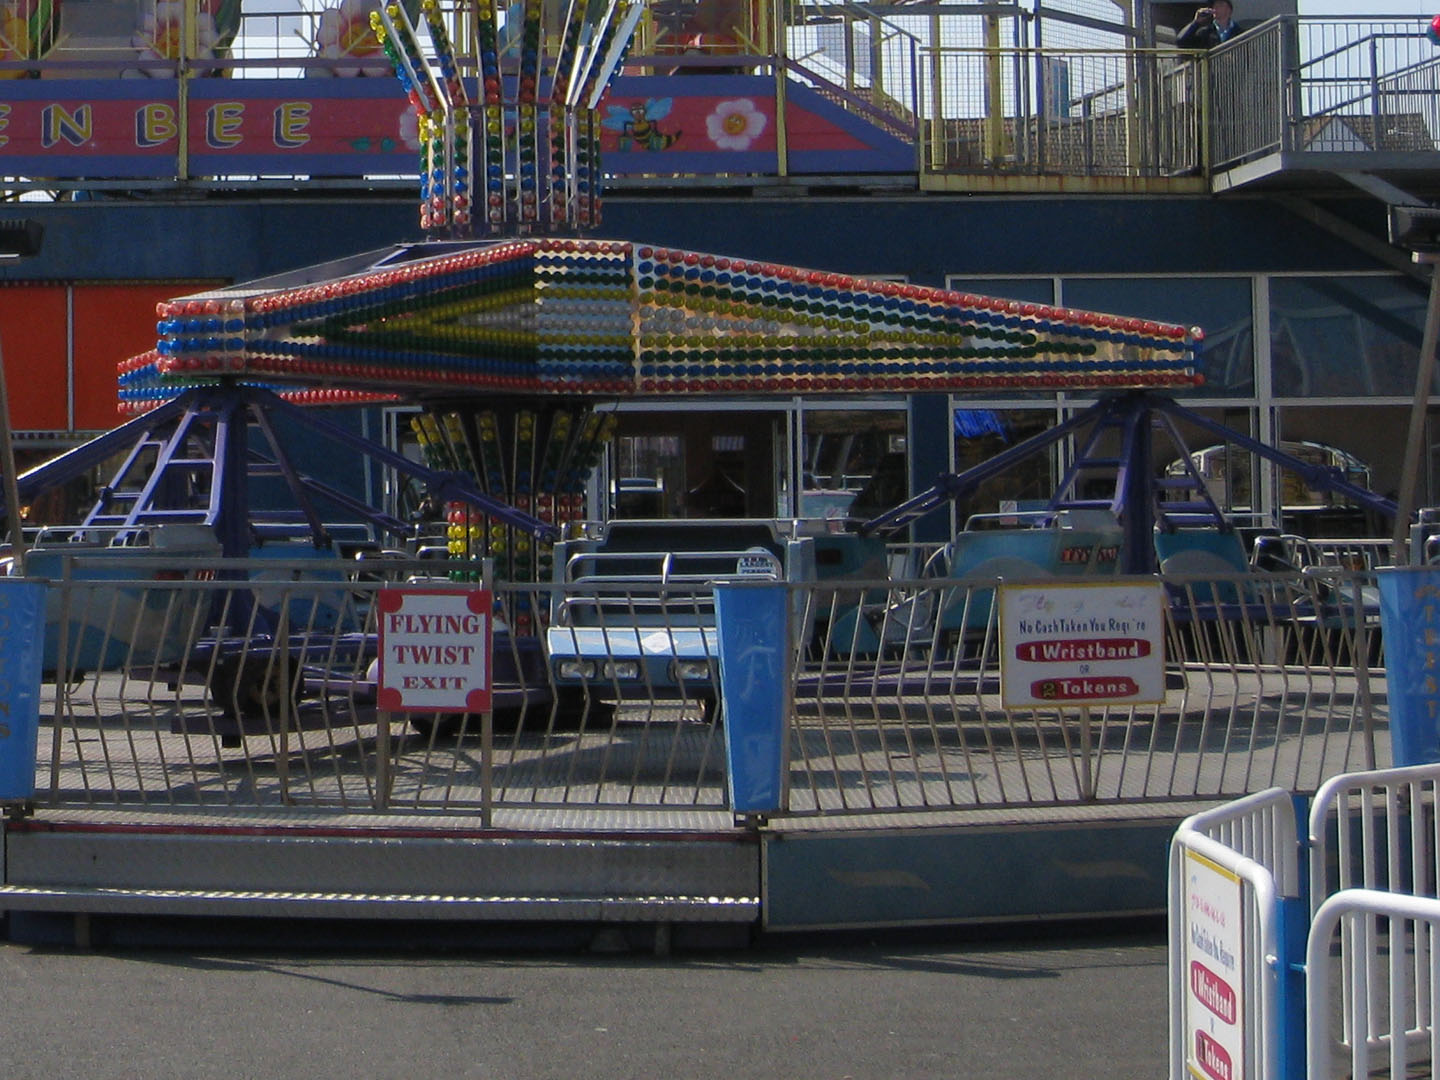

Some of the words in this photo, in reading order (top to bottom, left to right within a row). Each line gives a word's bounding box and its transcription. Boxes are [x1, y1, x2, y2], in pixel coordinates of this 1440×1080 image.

[135, 101, 312, 149] BEE
[389, 614, 480, 634] FLYING
[1019, 621, 1033, 634] No
[1035, 619, 1059, 634] Cash
[1060, 618, 1088, 633] Taken
[1090, 618, 1106, 632] You
[392, 645, 475, 665] TWIST
[1029, 645, 1037, 660] 1
[1042, 641, 1139, 659] Wristband
[1079, 664, 1090, 674] OR
[402, 676, 467, 689] EXIT
[1042, 682, 1056, 697] 2
[1060, 680, 1128, 694] Tokens
[1198, 969, 1233, 1023] Wristband
[1204, 1038, 1229, 1080] Tokens
